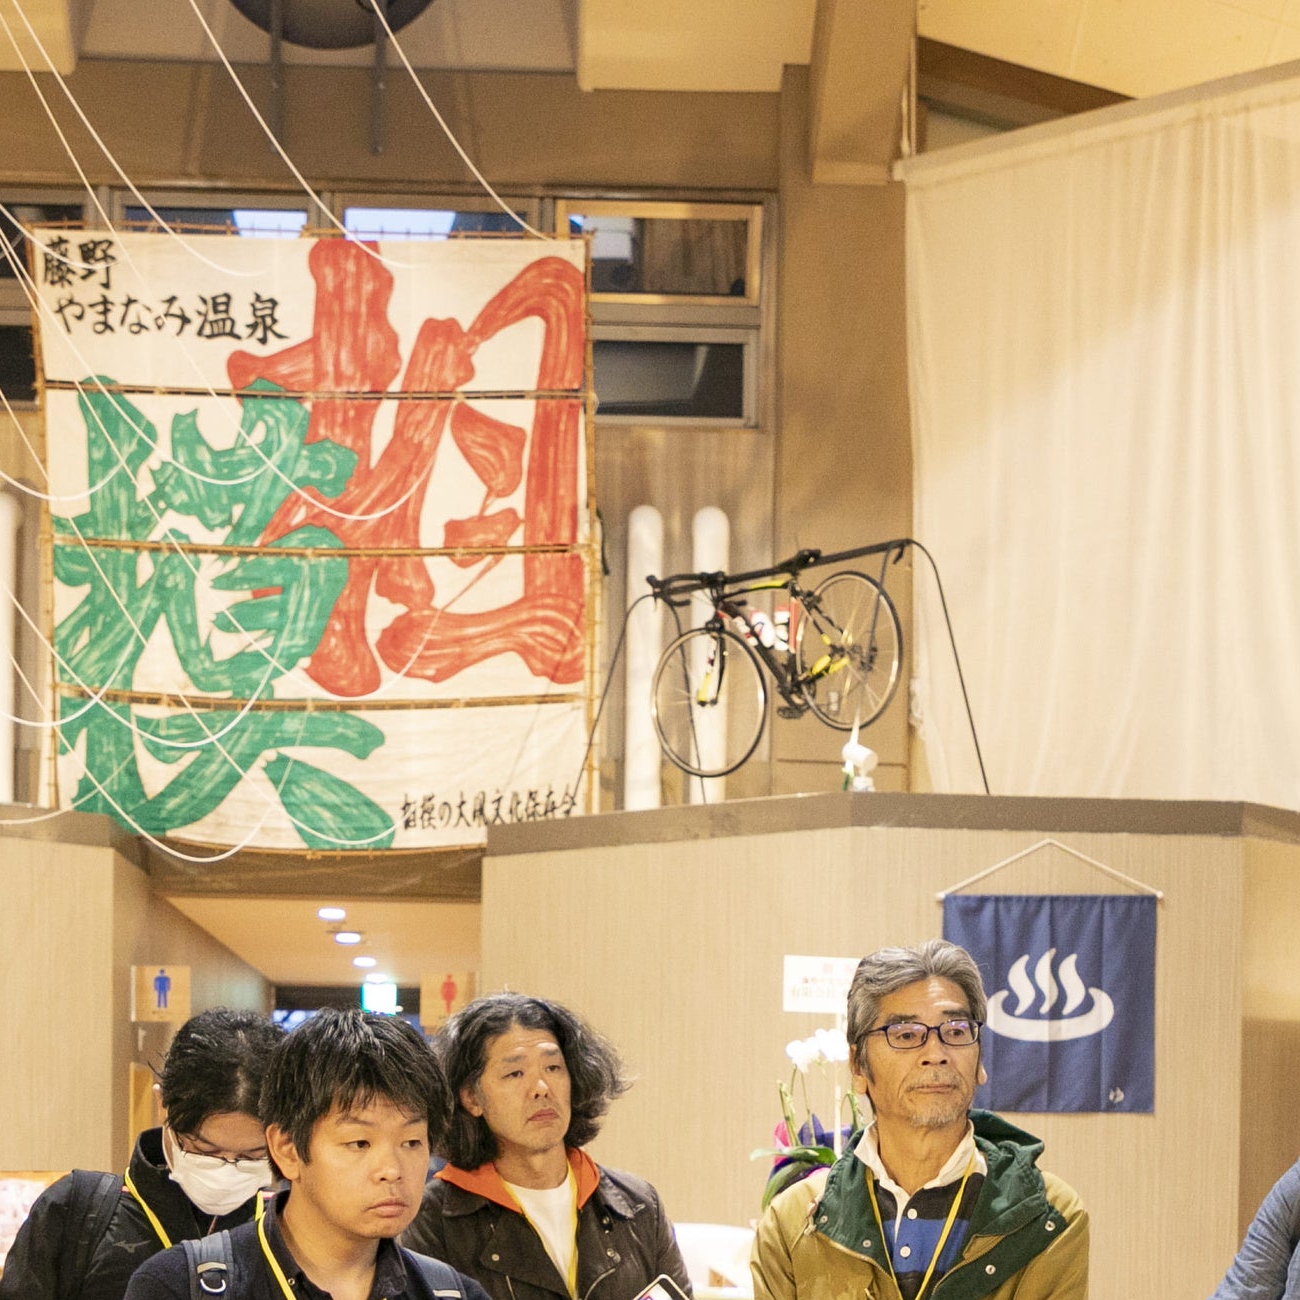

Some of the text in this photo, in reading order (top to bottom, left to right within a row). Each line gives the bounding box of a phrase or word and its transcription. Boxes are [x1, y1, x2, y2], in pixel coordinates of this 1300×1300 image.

[43, 236, 117, 290] 藤野
[54, 291, 290, 345] やまなみ温泉
